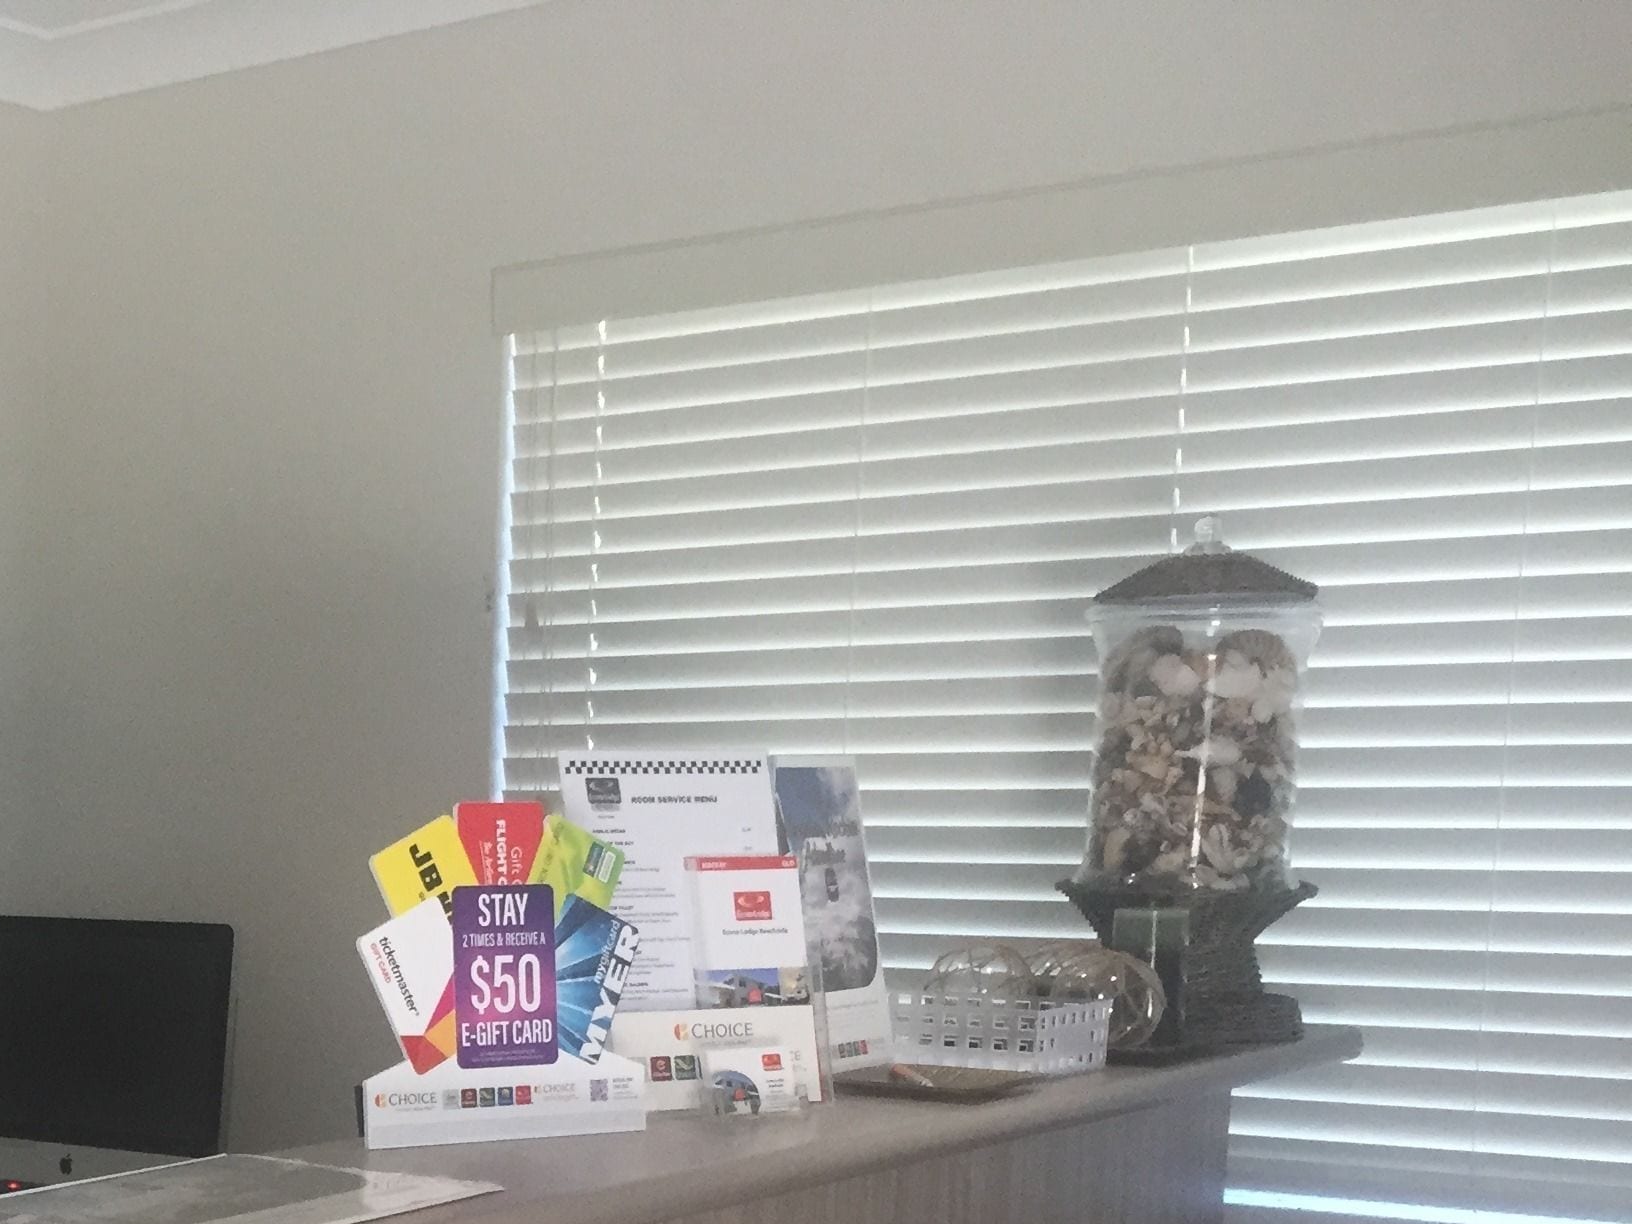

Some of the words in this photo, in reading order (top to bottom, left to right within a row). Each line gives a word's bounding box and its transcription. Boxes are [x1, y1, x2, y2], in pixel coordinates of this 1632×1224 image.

[658, 796, 692, 804] SERVICE
[496, 819, 507, 874] FLIGHT
[478, 893, 528, 927] STAY
[462, 935, 468, 947] 2
[469, 933, 495, 947] TIMES
[505, 932, 538, 946] RECEIVE
[539, 932, 546, 945] A
[471, 953, 541, 1014] $50
[579, 924, 640, 1065] MYER
[461, 1021, 509, 1047] E-GIFT
[512, 1019, 552, 1045] CARD
[691, 1022, 754, 1038] CHOICE
[388, 1092, 438, 1106] CHOICE
